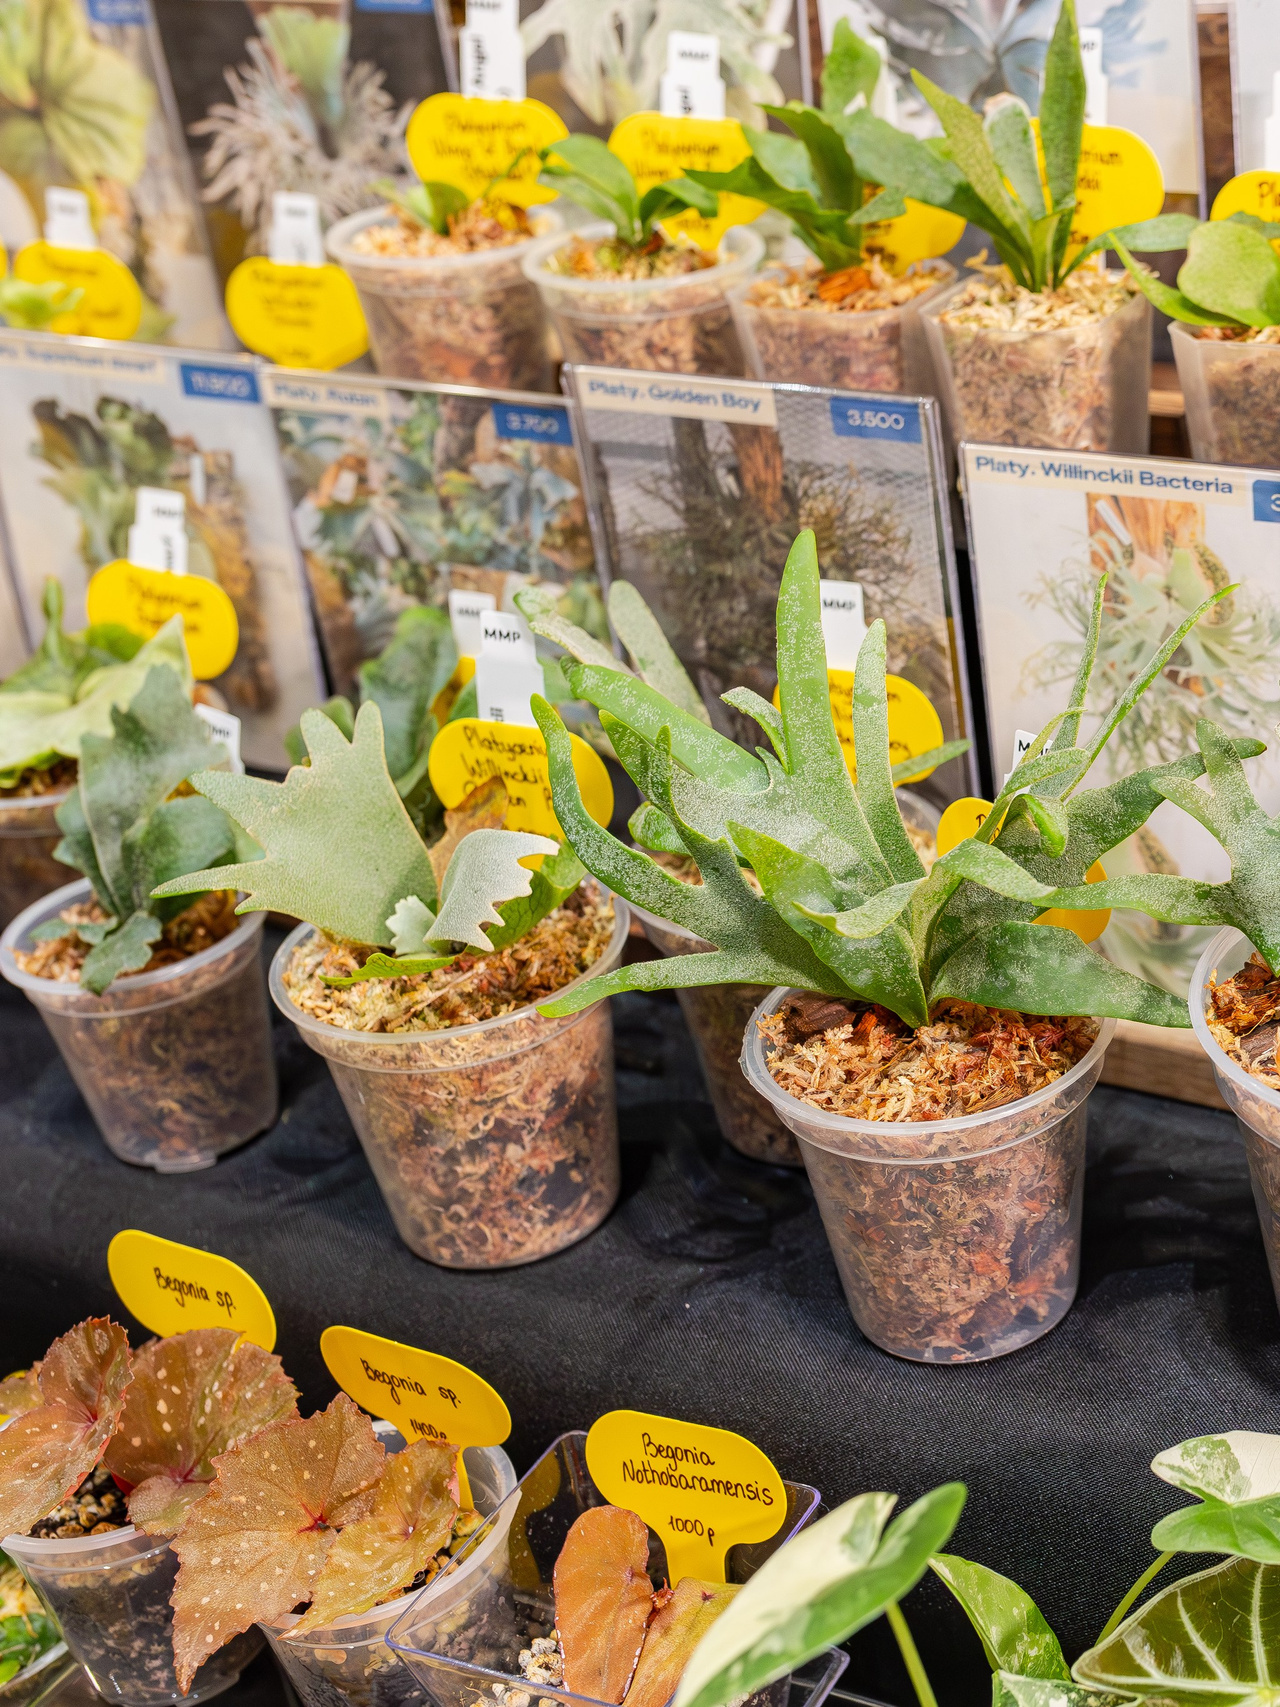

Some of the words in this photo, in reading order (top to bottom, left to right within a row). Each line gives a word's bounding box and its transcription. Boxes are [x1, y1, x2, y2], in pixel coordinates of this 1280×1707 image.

[589, 379, 645, 401] Platy.
[648, 383, 719, 407] Golden
[721, 391, 762, 414] Boy
[846, 409, 906, 432] 3.500
[975, 455, 1036, 479] Platy.
[1040, 460, 1134, 486] Willinckii
[1139, 470, 1234, 495] Bacteria
[484, 627, 521, 644] MMP
[152, 1266, 211, 1308] Begonia
[216, 1289, 237, 1318] sp.
[359, 1356, 428, 1406] Begonia
[438, 1384, 462, 1408] sp.
[641, 1432, 716, 1473] Begonia
[622, 1459, 775, 1507] Nothobaramensis
